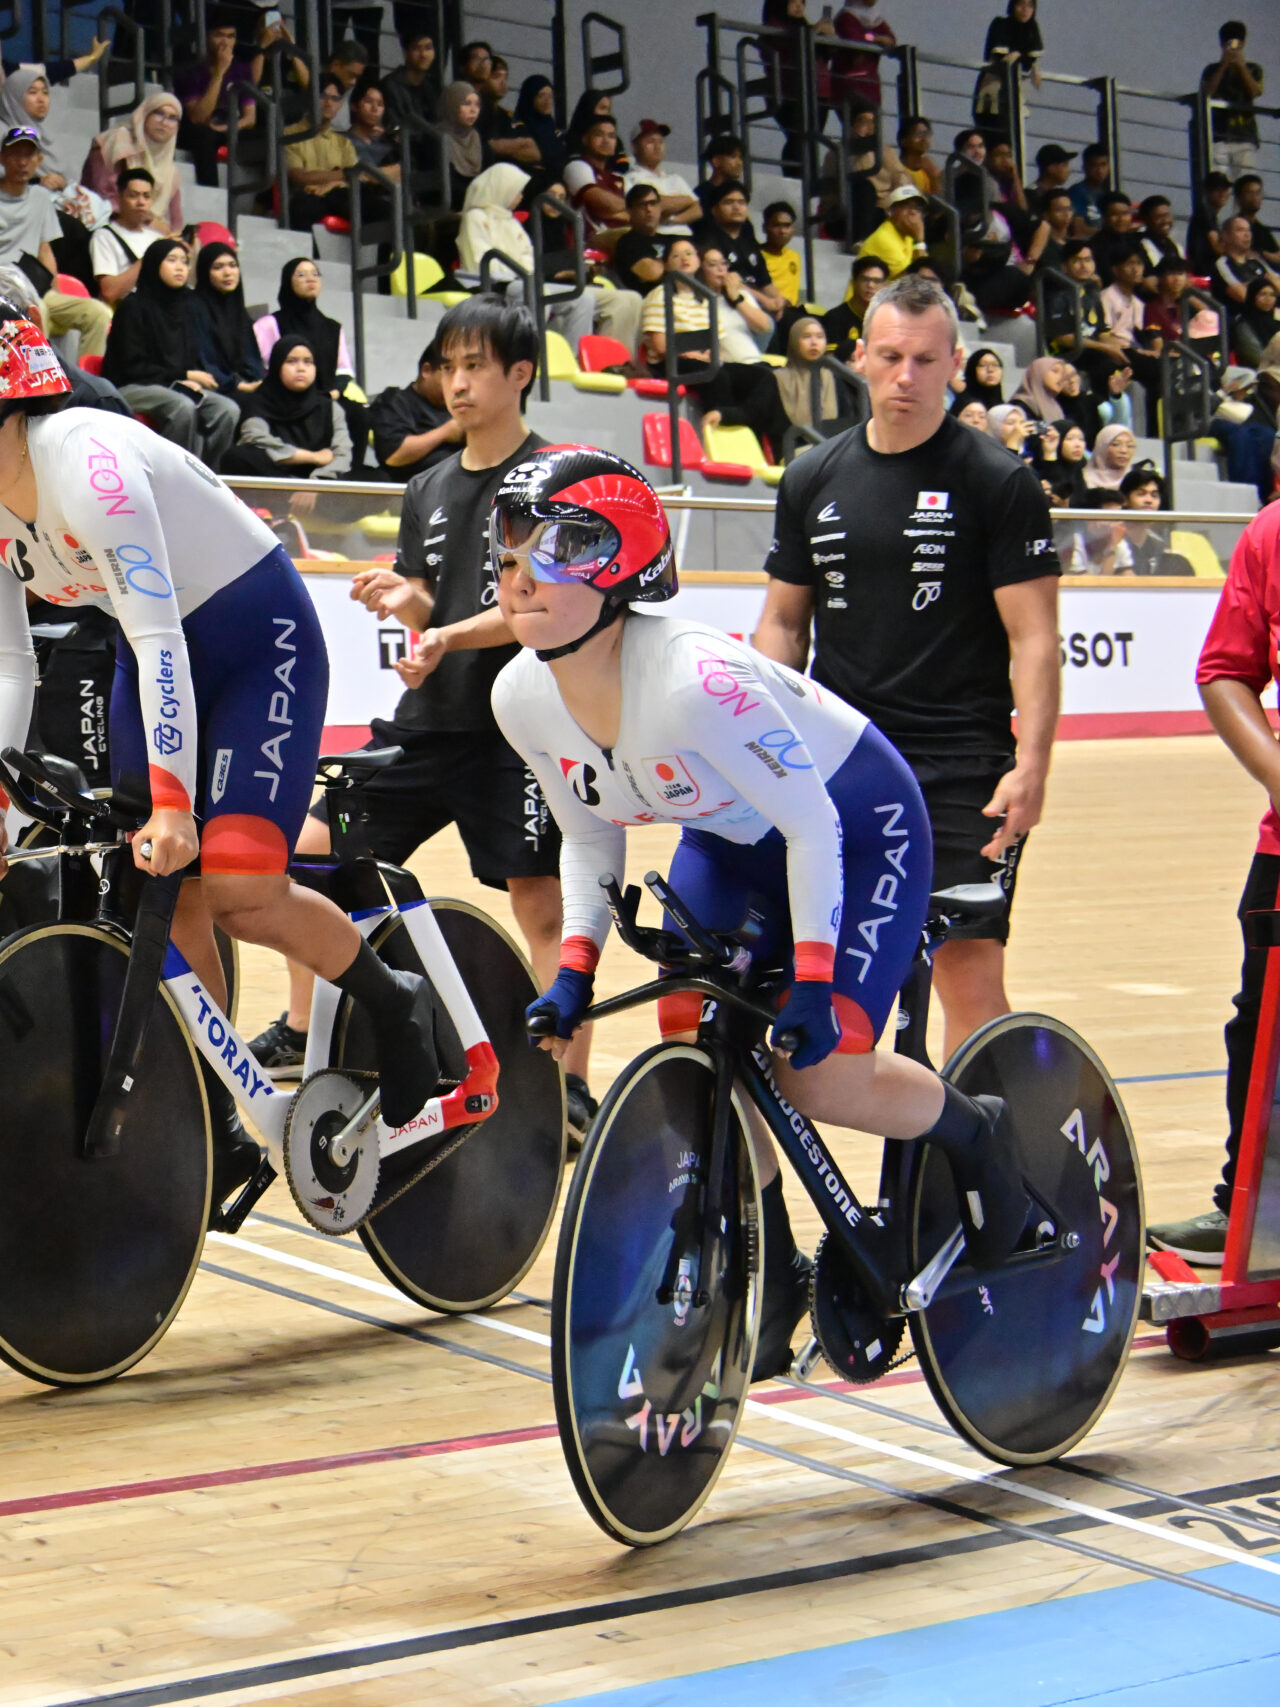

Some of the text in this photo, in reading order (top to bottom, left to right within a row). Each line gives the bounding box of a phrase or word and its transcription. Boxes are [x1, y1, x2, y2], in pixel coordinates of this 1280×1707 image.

[908, 511, 954, 520] JAPAN
[103, 548, 129, 595] KEIRIN
[156, 649, 181, 719] Cyclers
[79, 679, 99, 770] JAPAN
[96, 696, 107, 753] CYCLING
[253, 618, 297, 803] JAPAN
[744, 740, 788, 779] KEIRIN
[663, 786, 694, 800] JAPAN
[664, 783, 682, 791] TEAM
[845, 802, 910, 984] JAPAN
[388, 1111, 439, 1140] JAPAN
[1059, 1107, 1120, 1334] ARAYA
